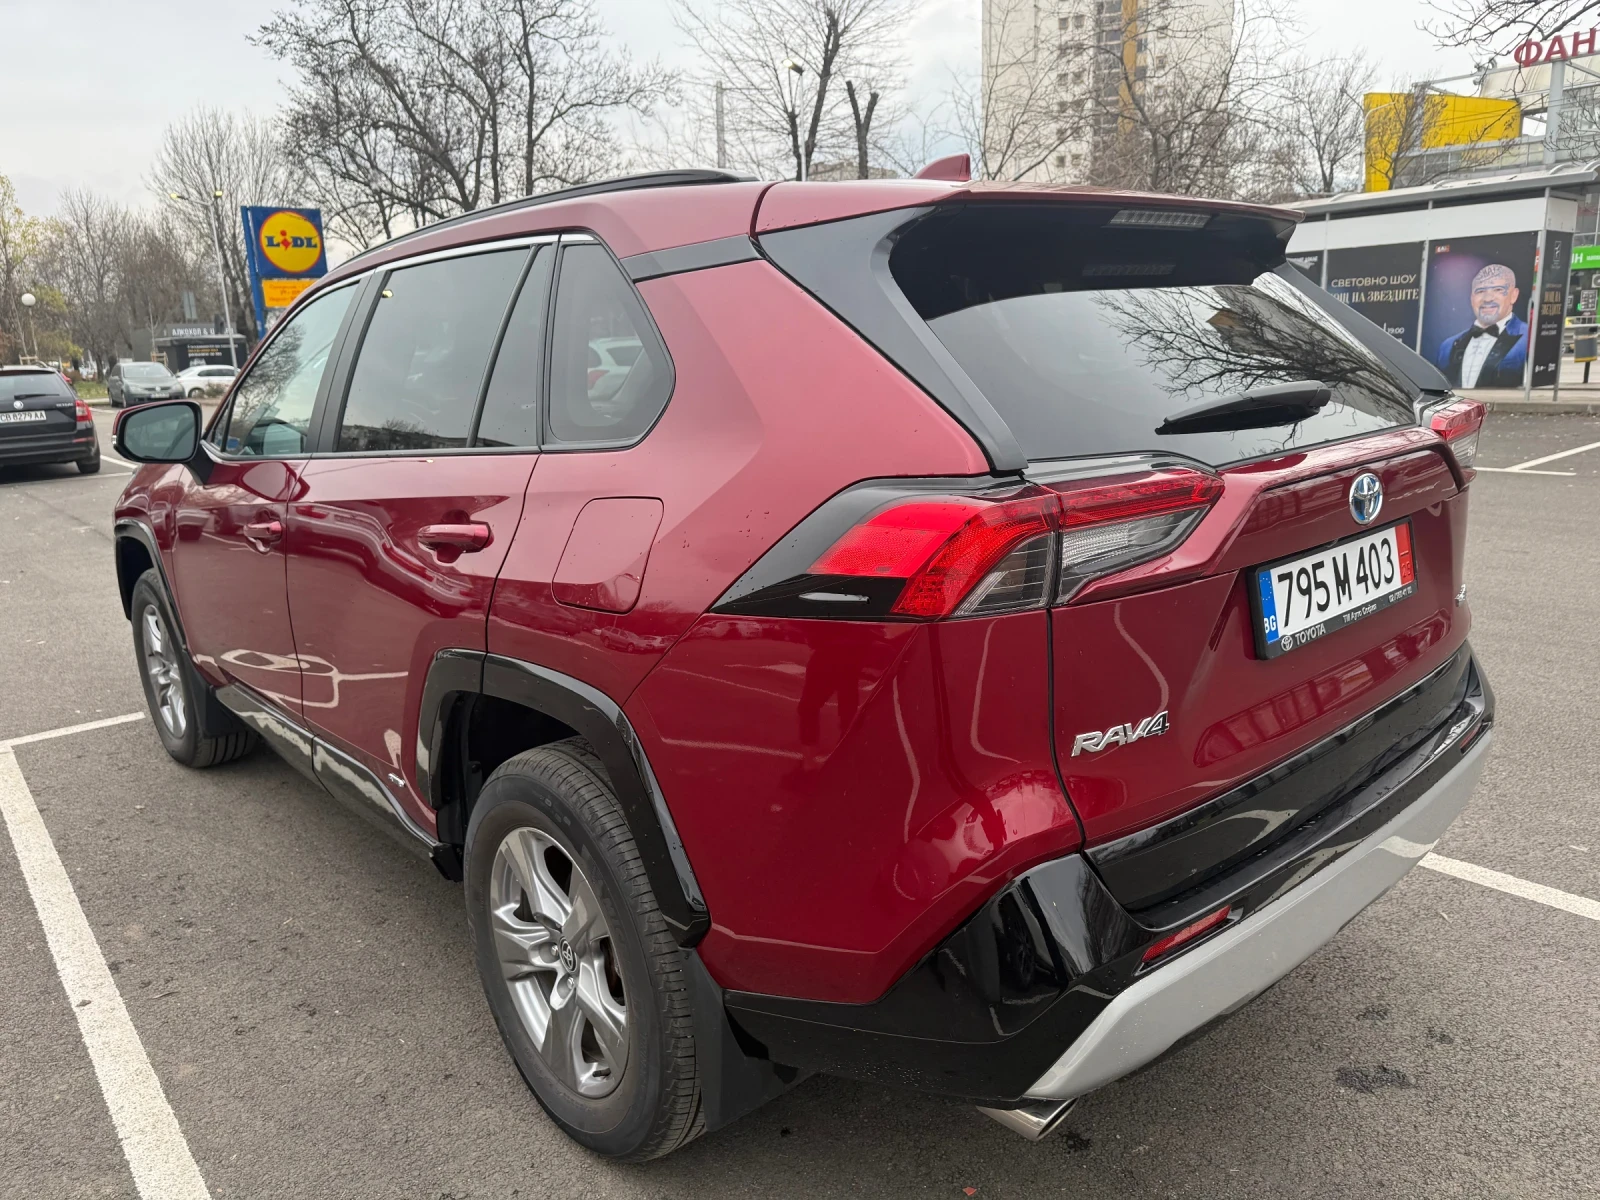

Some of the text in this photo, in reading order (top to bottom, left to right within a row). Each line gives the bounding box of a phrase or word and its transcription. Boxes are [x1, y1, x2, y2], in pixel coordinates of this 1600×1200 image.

[1514, 28, 1596, 67] ФАН
[1331, 274, 1416, 288] СВЕТОВНО ШОУ
[1352, 290, 1366, 303] НА
[1367, 288, 1419, 303] ЗВЕЗДИТЕ
[13, 411, 32, 420] 8279
[34, 410, 44, 419] AA
[1277, 537, 1395, 628] 795 M 403
[1263, 615, 1277, 633] BG
[1295, 623, 1326, 645] TOYOTA
[1071, 710, 1170, 757] RAV4
